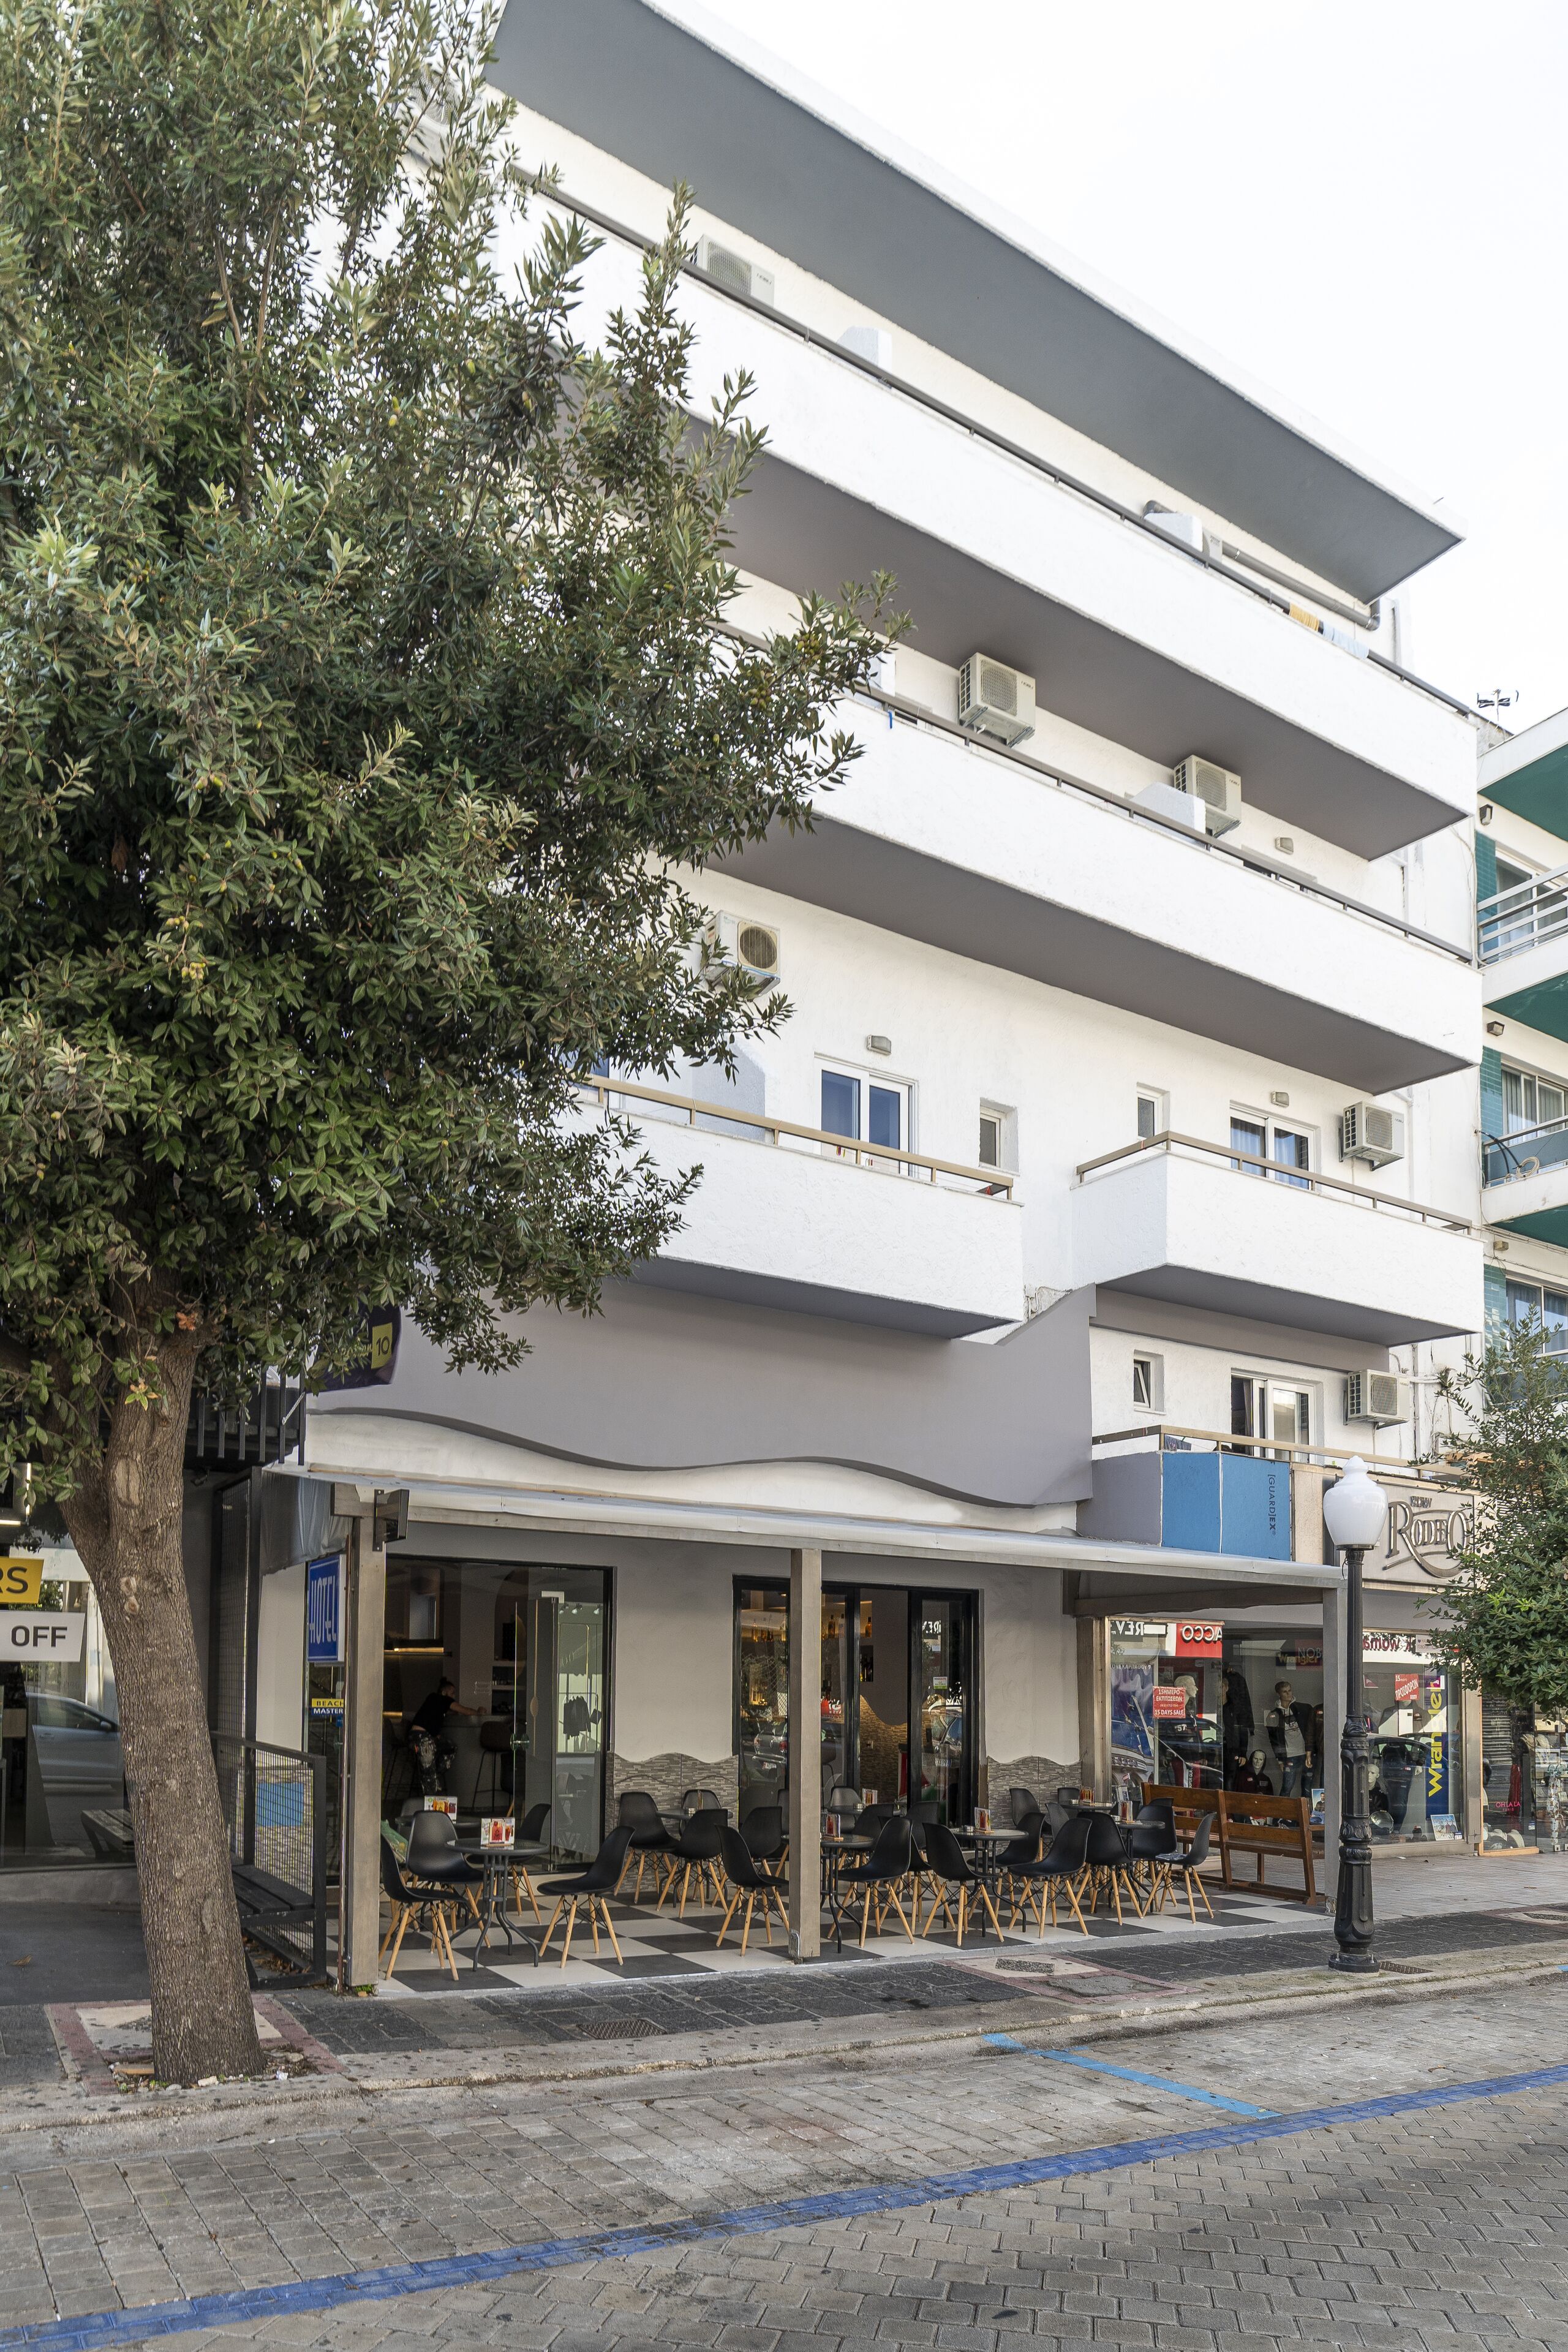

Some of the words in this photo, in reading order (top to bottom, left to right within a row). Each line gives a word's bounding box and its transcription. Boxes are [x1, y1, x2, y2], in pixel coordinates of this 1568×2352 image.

[375, 1335, 391, 1357] 10
[1384, 1501, 1471, 1578] RODEO
[0, 1566, 28, 1594] S
[309, 1575, 336, 1645] HOTEL
[11, 1625, 67, 1647] OFF
[1428, 1681, 1443, 1798] Wrangler
